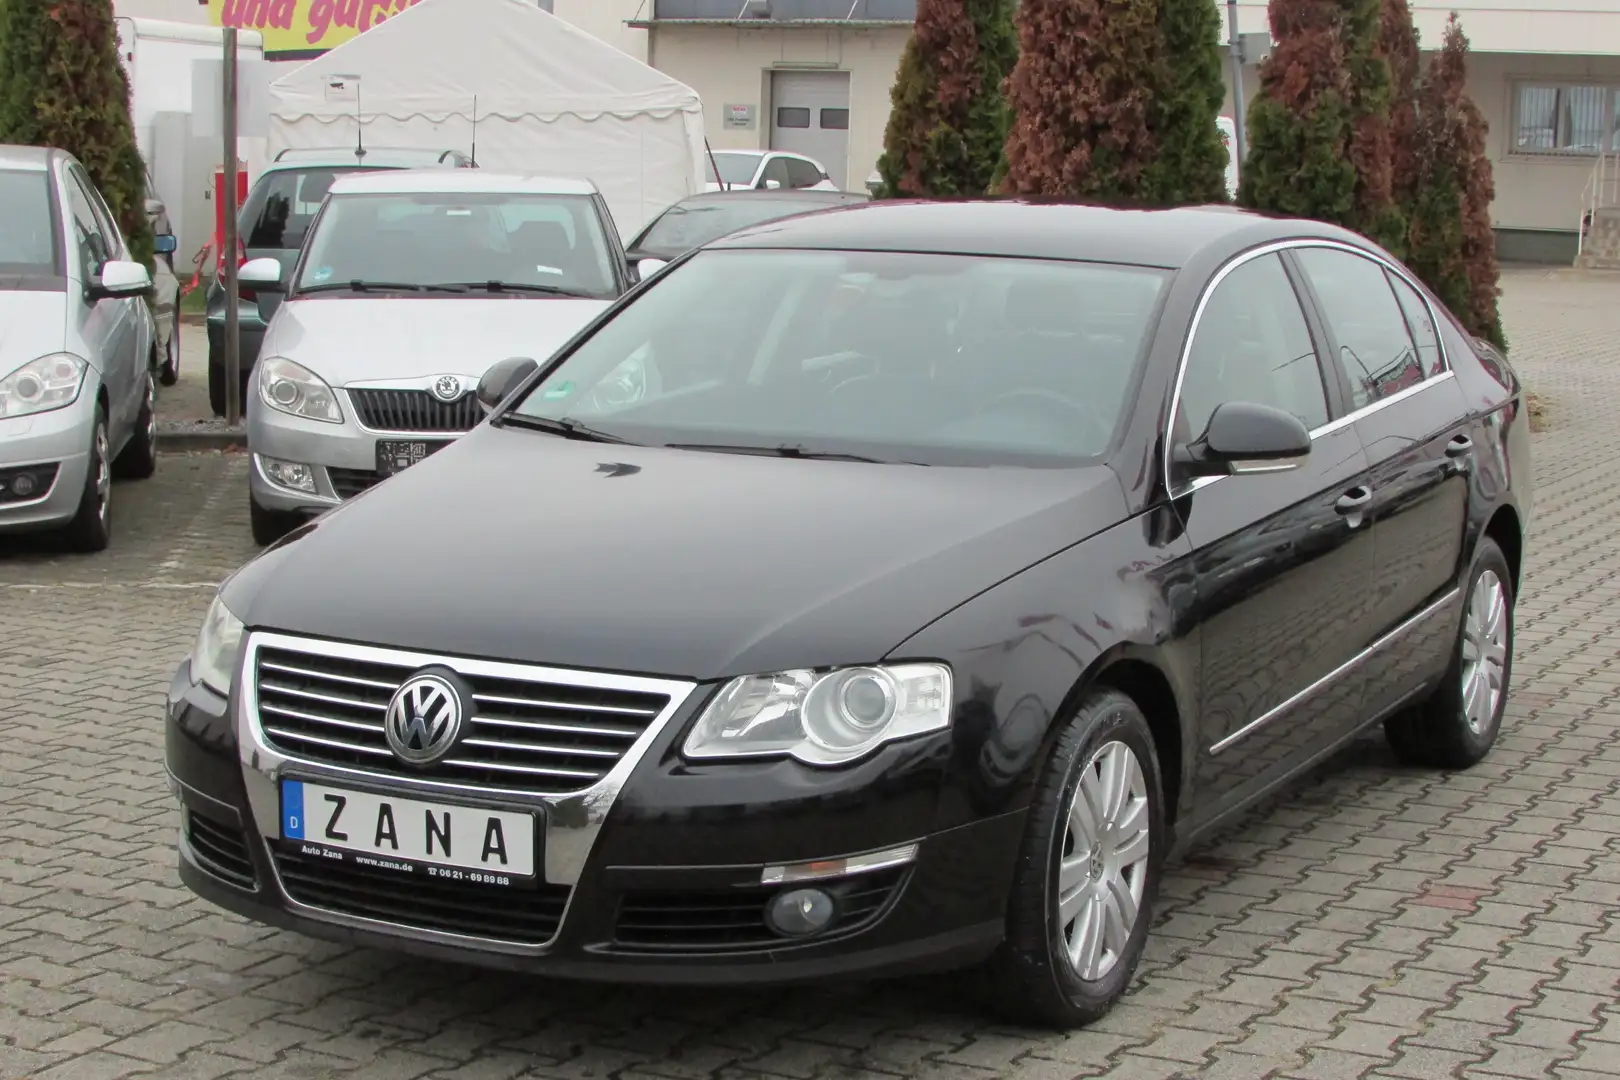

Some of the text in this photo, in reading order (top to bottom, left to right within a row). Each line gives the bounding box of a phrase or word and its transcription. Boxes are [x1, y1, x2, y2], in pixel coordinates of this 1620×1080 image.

[289, 815, 299, 830] D
[324, 793, 508, 865] ZANA
[302, 845, 413, 872] Auto Zana www.zana.de
